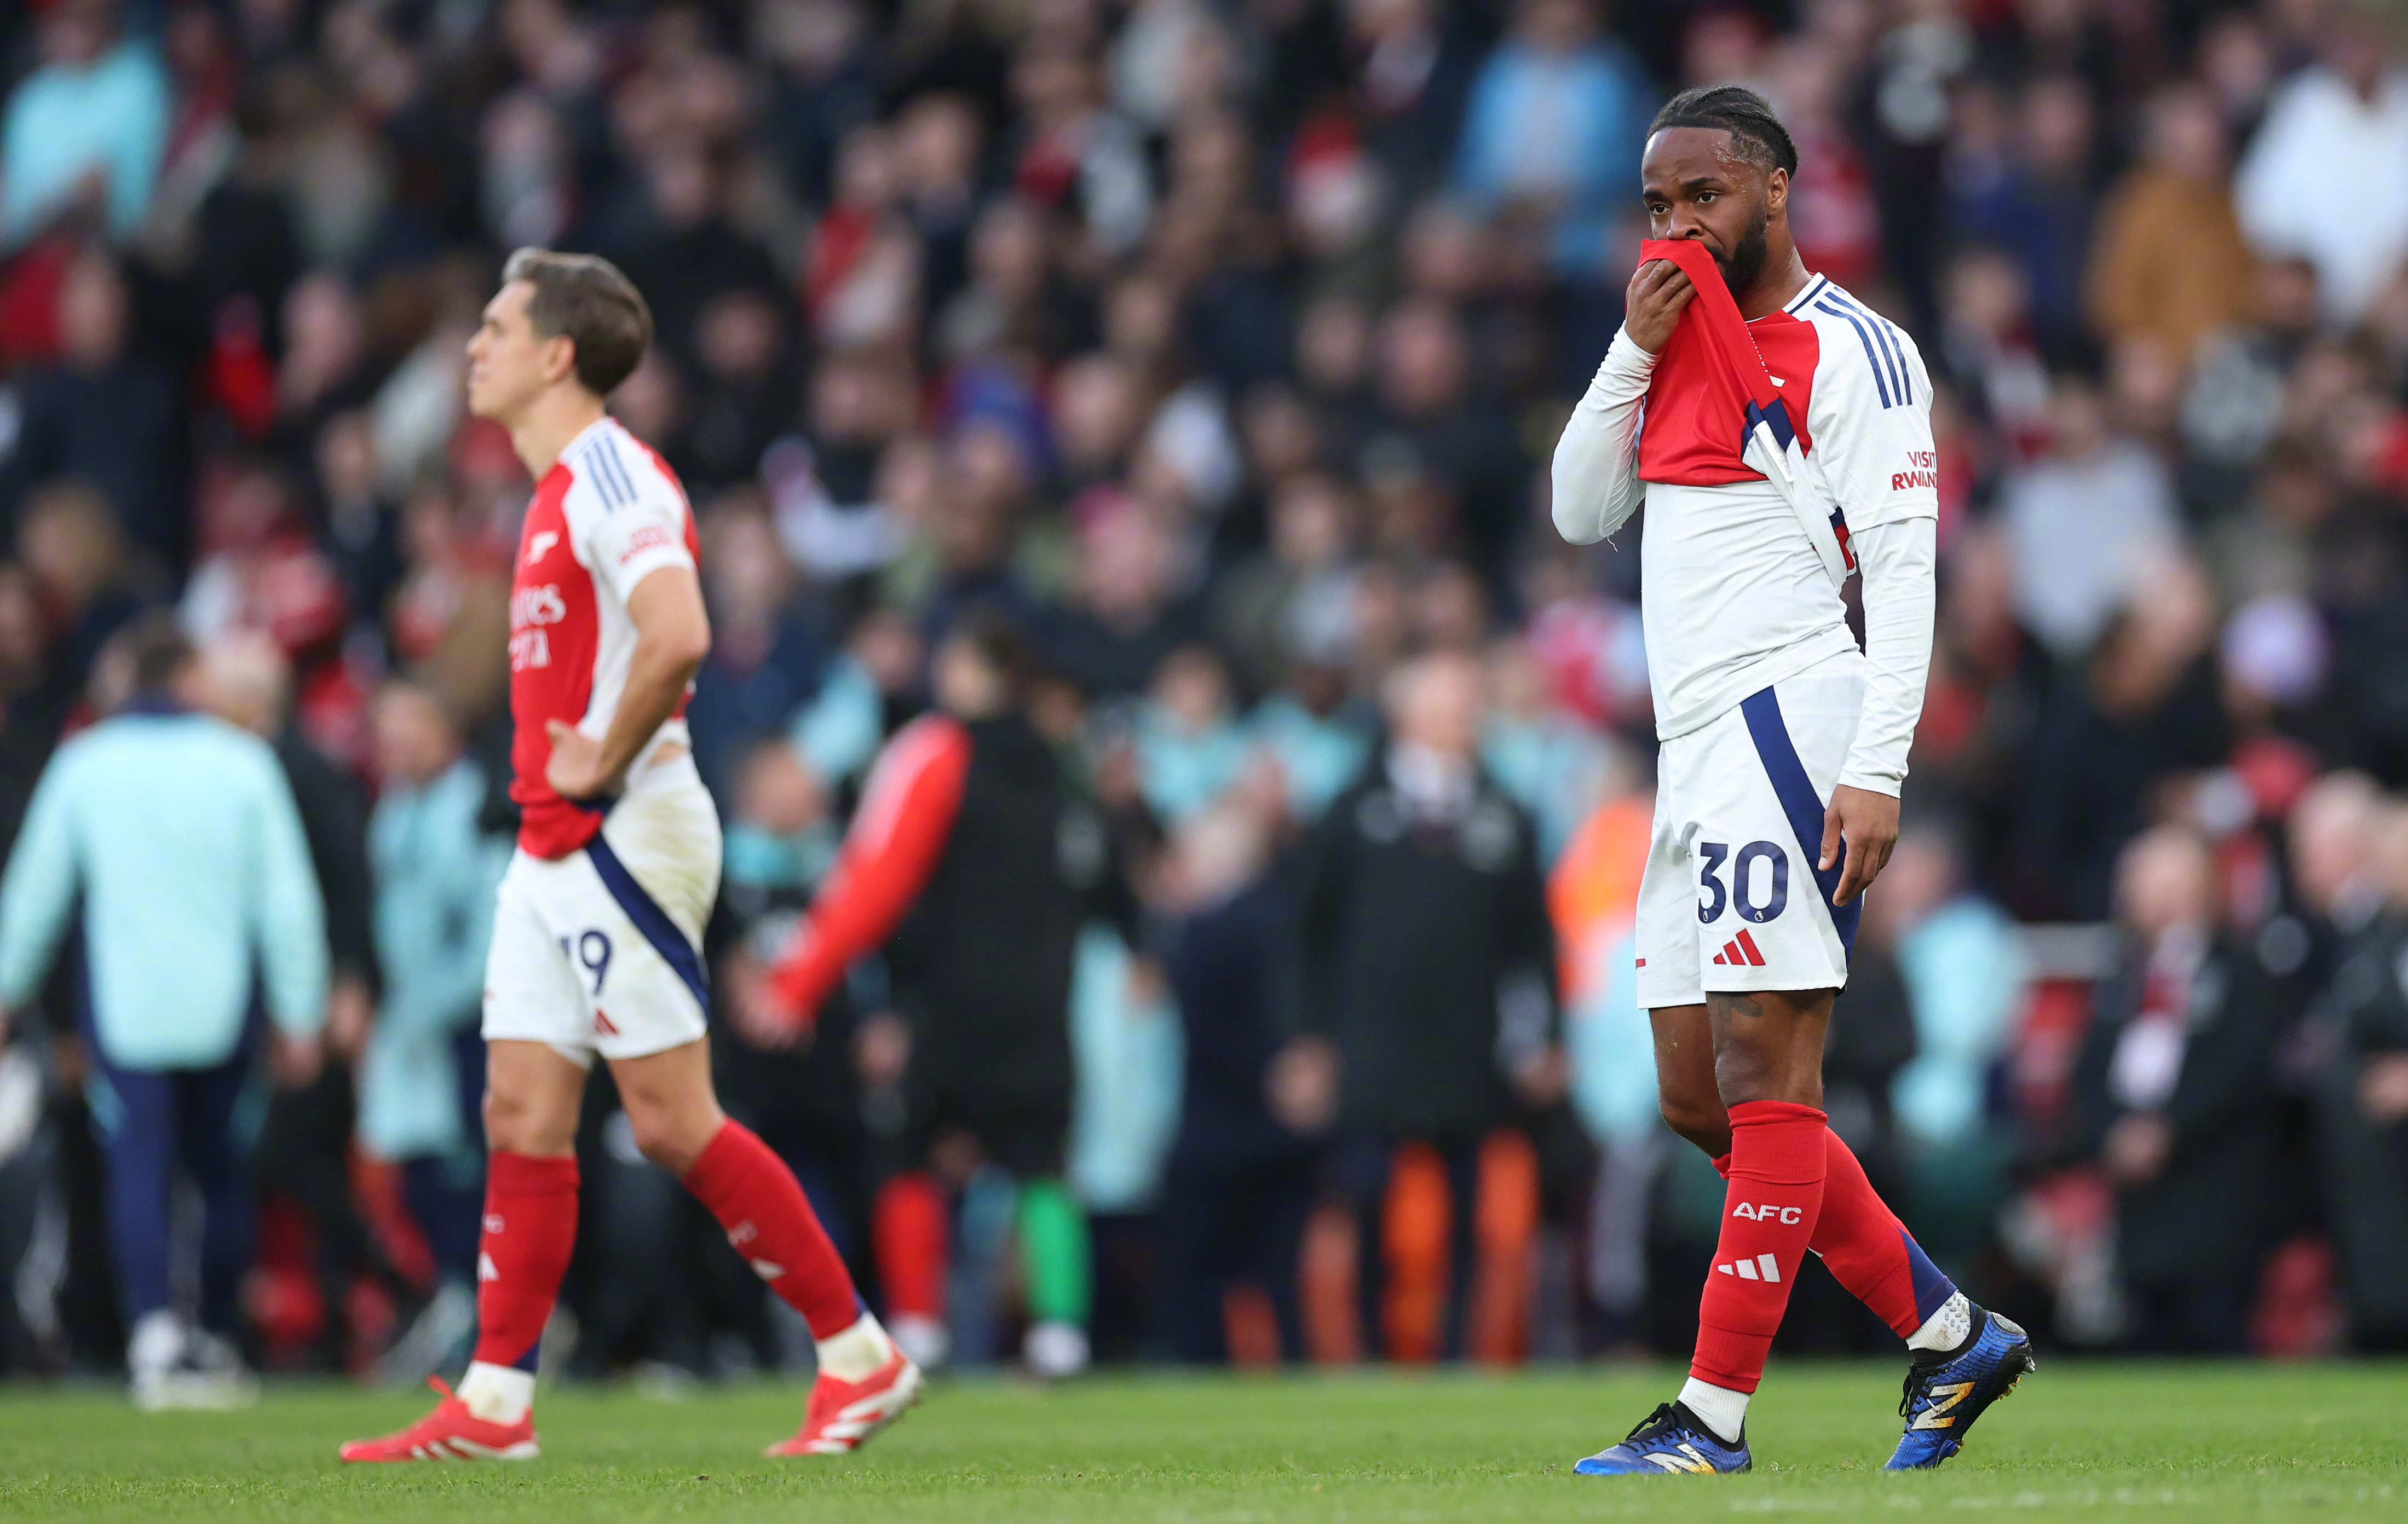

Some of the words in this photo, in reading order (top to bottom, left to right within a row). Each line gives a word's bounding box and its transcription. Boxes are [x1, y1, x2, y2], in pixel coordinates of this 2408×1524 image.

[1907, 451, 1935, 468] VISIT
[1698, 840, 1789, 924] 30
[1732, 1202, 1802, 1225] AFC
